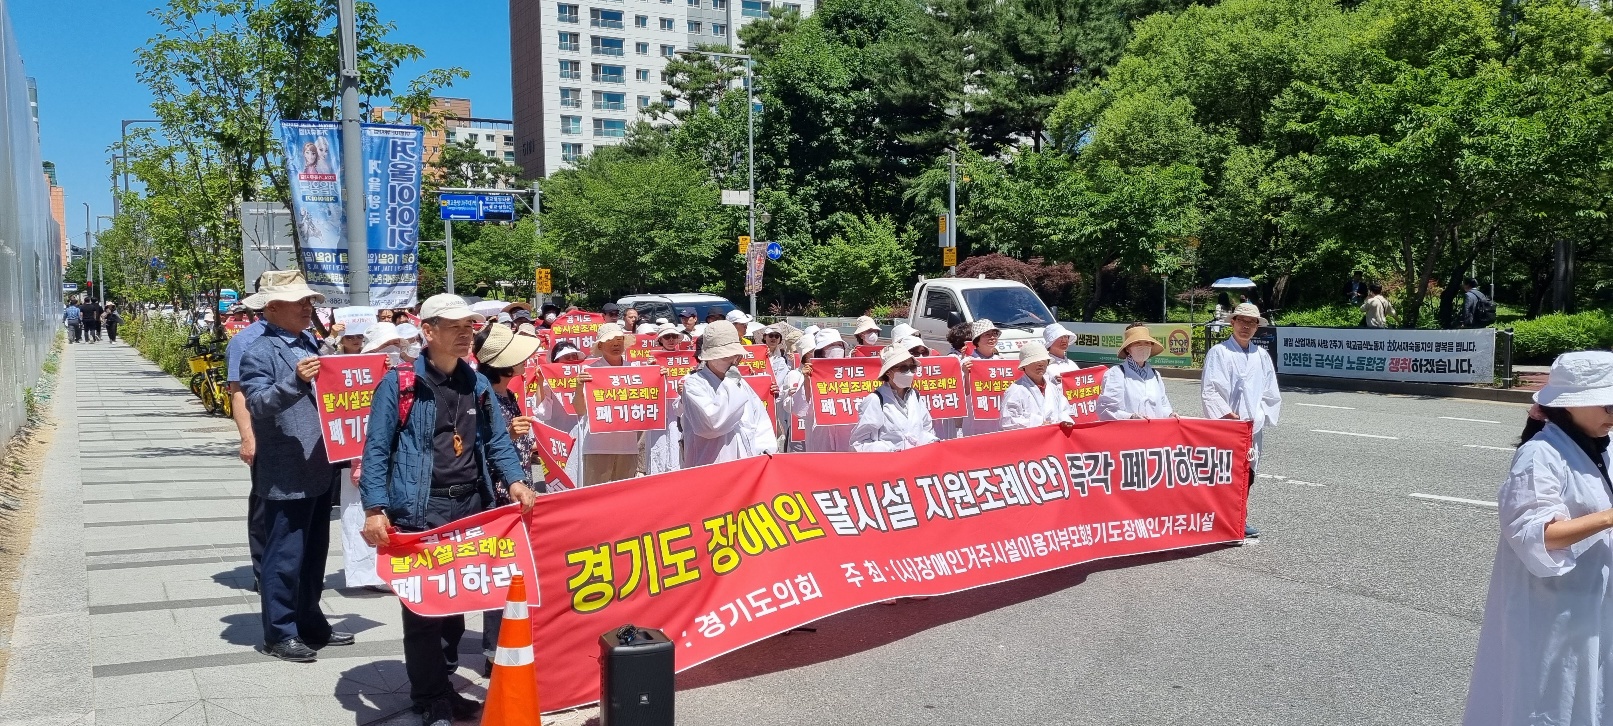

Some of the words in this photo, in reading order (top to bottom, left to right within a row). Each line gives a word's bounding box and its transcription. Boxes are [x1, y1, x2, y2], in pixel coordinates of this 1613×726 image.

[566, 315, 592, 324] 경기도
[1169, 339, 1188, 347] STOP
[1434, 341, 1454, 352] 명복을
[666, 356, 690, 366] 경기도
[1283, 352, 1313, 368] 안전한
[1314, 353, 1345, 370] 급식실
[1345, 355, 1387, 372] 노동환경
[1388, 357, 1476, 374] 쟁취하겠습니다.
[342, 367, 374, 387] 경기도
[834, 366, 866, 379] 경기도
[988, 367, 1014, 379] 경기도
[547, 377, 578, 389] 탈시설
[609, 374, 643, 387] 경기도
[912, 376, 957, 391] 시설조례안
[1074, 374, 1095, 387] 경기도
[592, 387, 660, 402] 탈시설조례안
[1065, 384, 1103, 401] 탈시설조례
[322, 389, 375, 413] 탈시설조
[595, 403, 660, 424] 폐기하라
[549, 436, 569, 458] 경기도
[565, 523, 702, 614] 경기도
[701, 489, 828, 577] 장애인
[811, 477, 919, 537] 탈시설
[914, 454, 1071, 521] 지원조례(안)
[1064, 451, 1115, 497] 즉각
[1119, 444, 1233, 491] 폐기하라!!
[389, 536, 517, 574] 탈시설조례안
[390, 562, 525, 604] 폐기하라
[694, 571, 824, 639] 경기도의회
